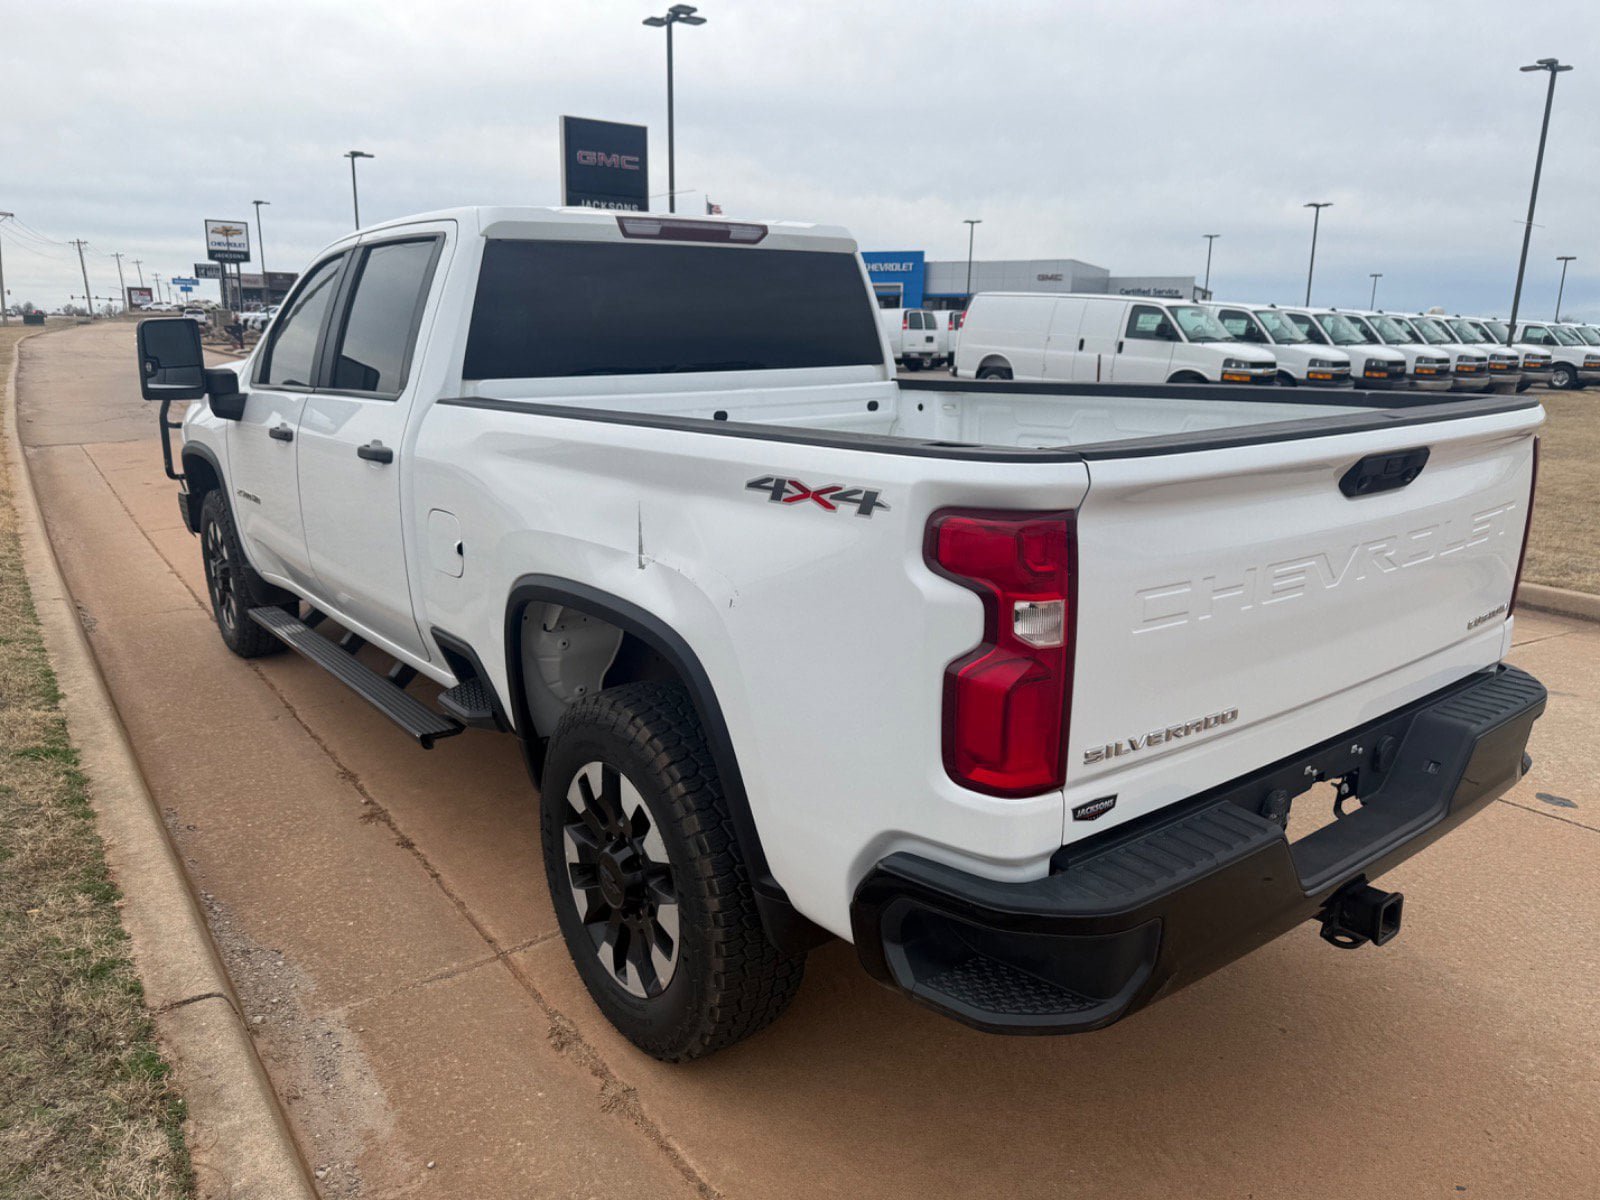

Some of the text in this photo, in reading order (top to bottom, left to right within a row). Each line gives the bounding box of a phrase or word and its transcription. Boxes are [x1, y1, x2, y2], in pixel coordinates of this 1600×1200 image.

[577, 150, 640, 170] GMC
[580, 199, 639, 212] JACKSONS
[211, 241, 246, 249] CHEVROLET
[1037, 273, 1063, 281] GMC
[1119, 288, 1180, 296] Certified Service
[1131, 502, 1516, 635] CHEVROLET
[1083, 706, 1239, 765] SILVERADO
[1076, 798, 1114, 818] JACKSONS
